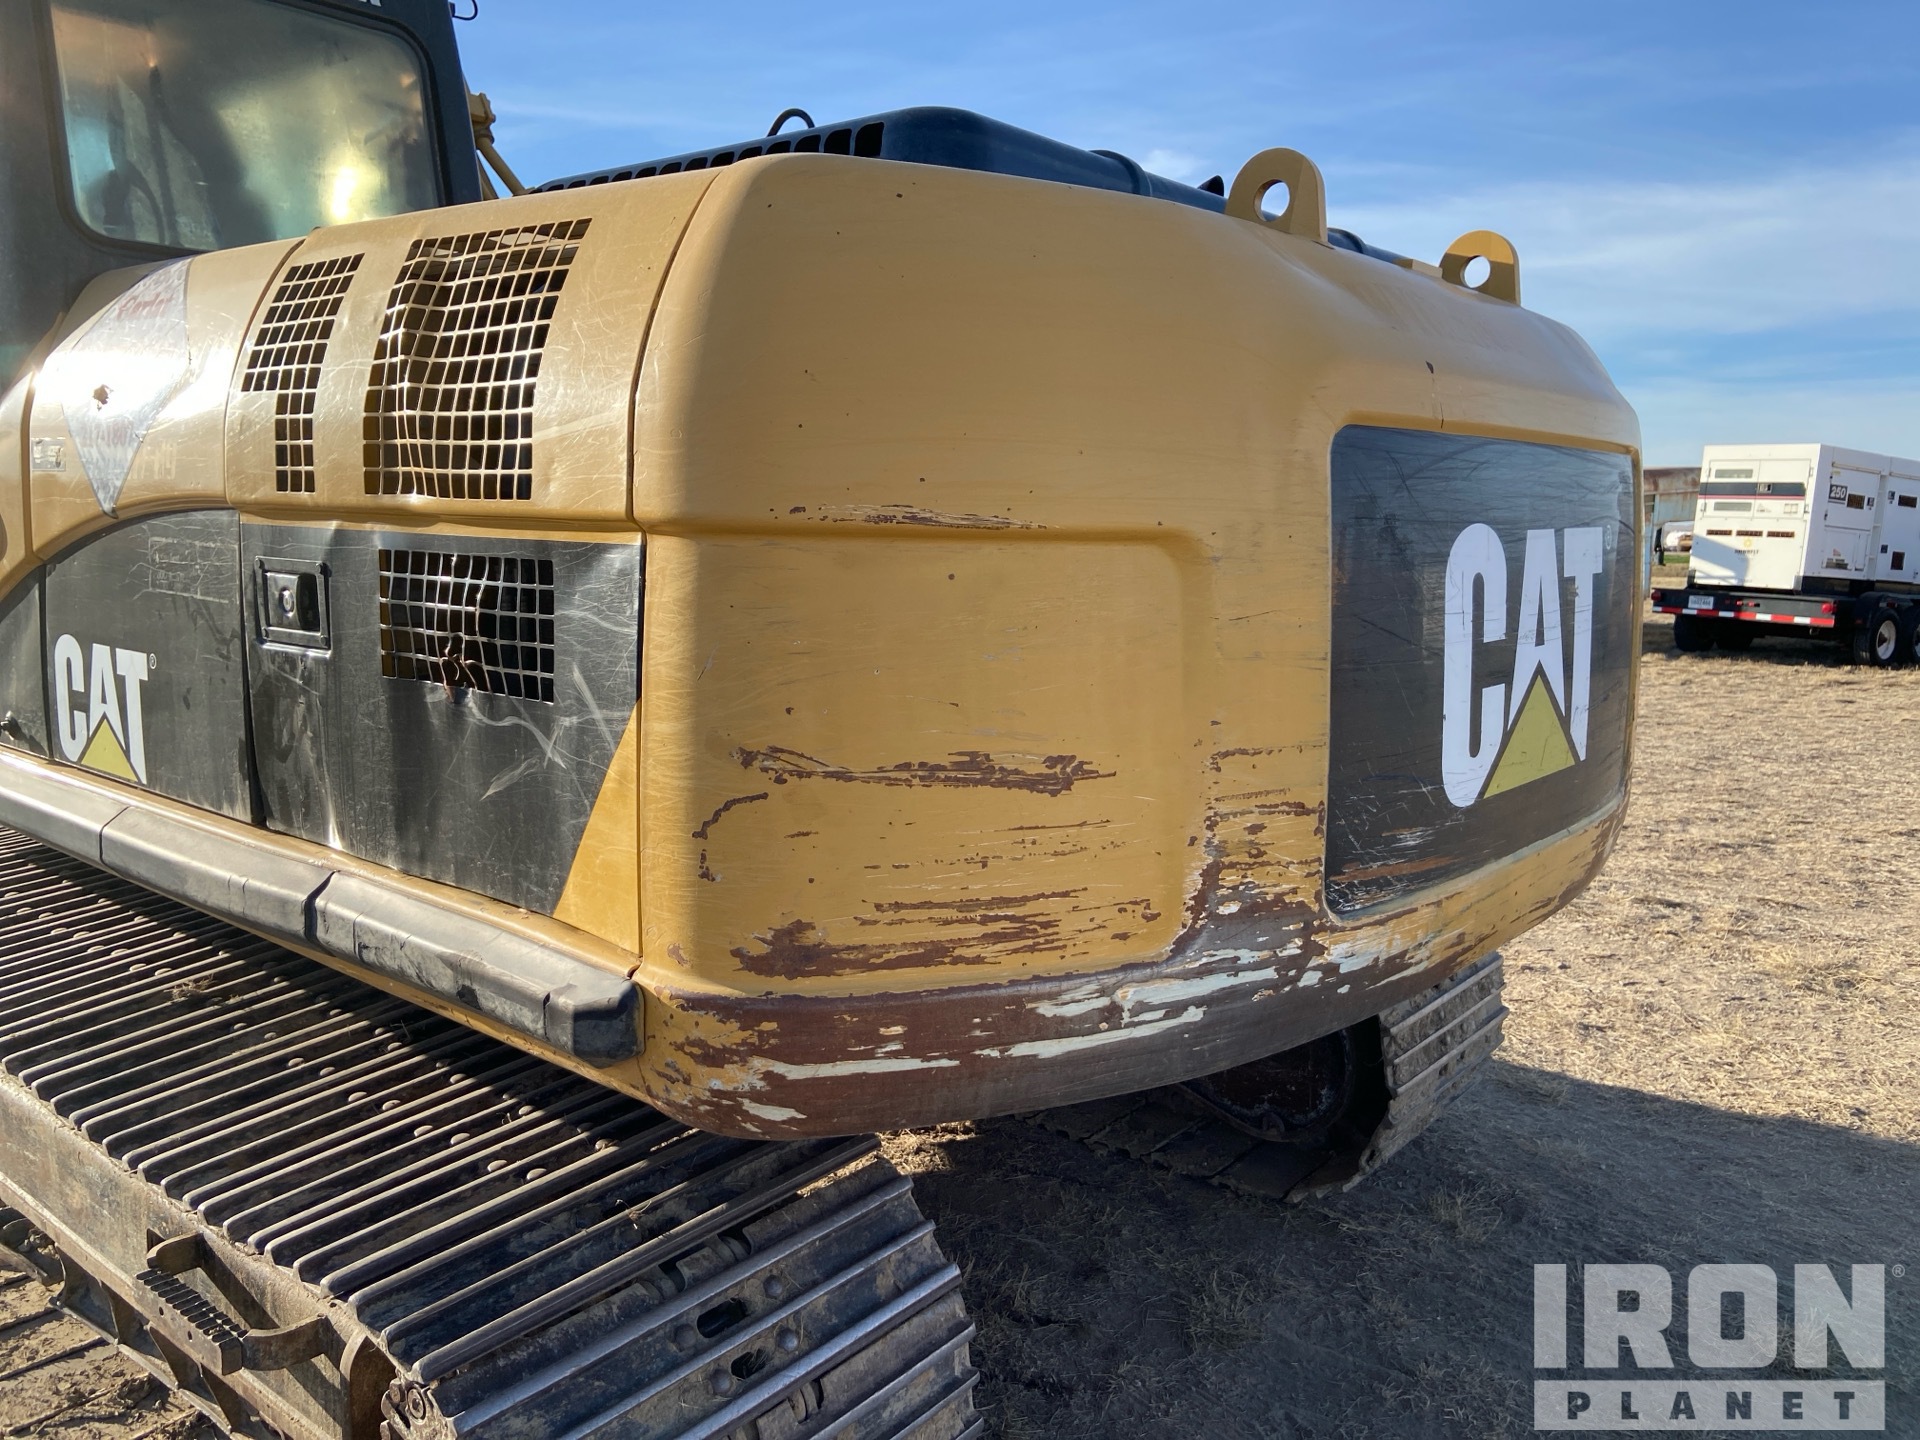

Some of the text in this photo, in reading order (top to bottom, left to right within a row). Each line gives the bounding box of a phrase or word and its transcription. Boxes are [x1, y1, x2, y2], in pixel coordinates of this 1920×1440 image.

[1830, 486, 1846, 499] 250
[55, 634, 148, 785] CAT
[1442, 523, 1603, 807] CAT
